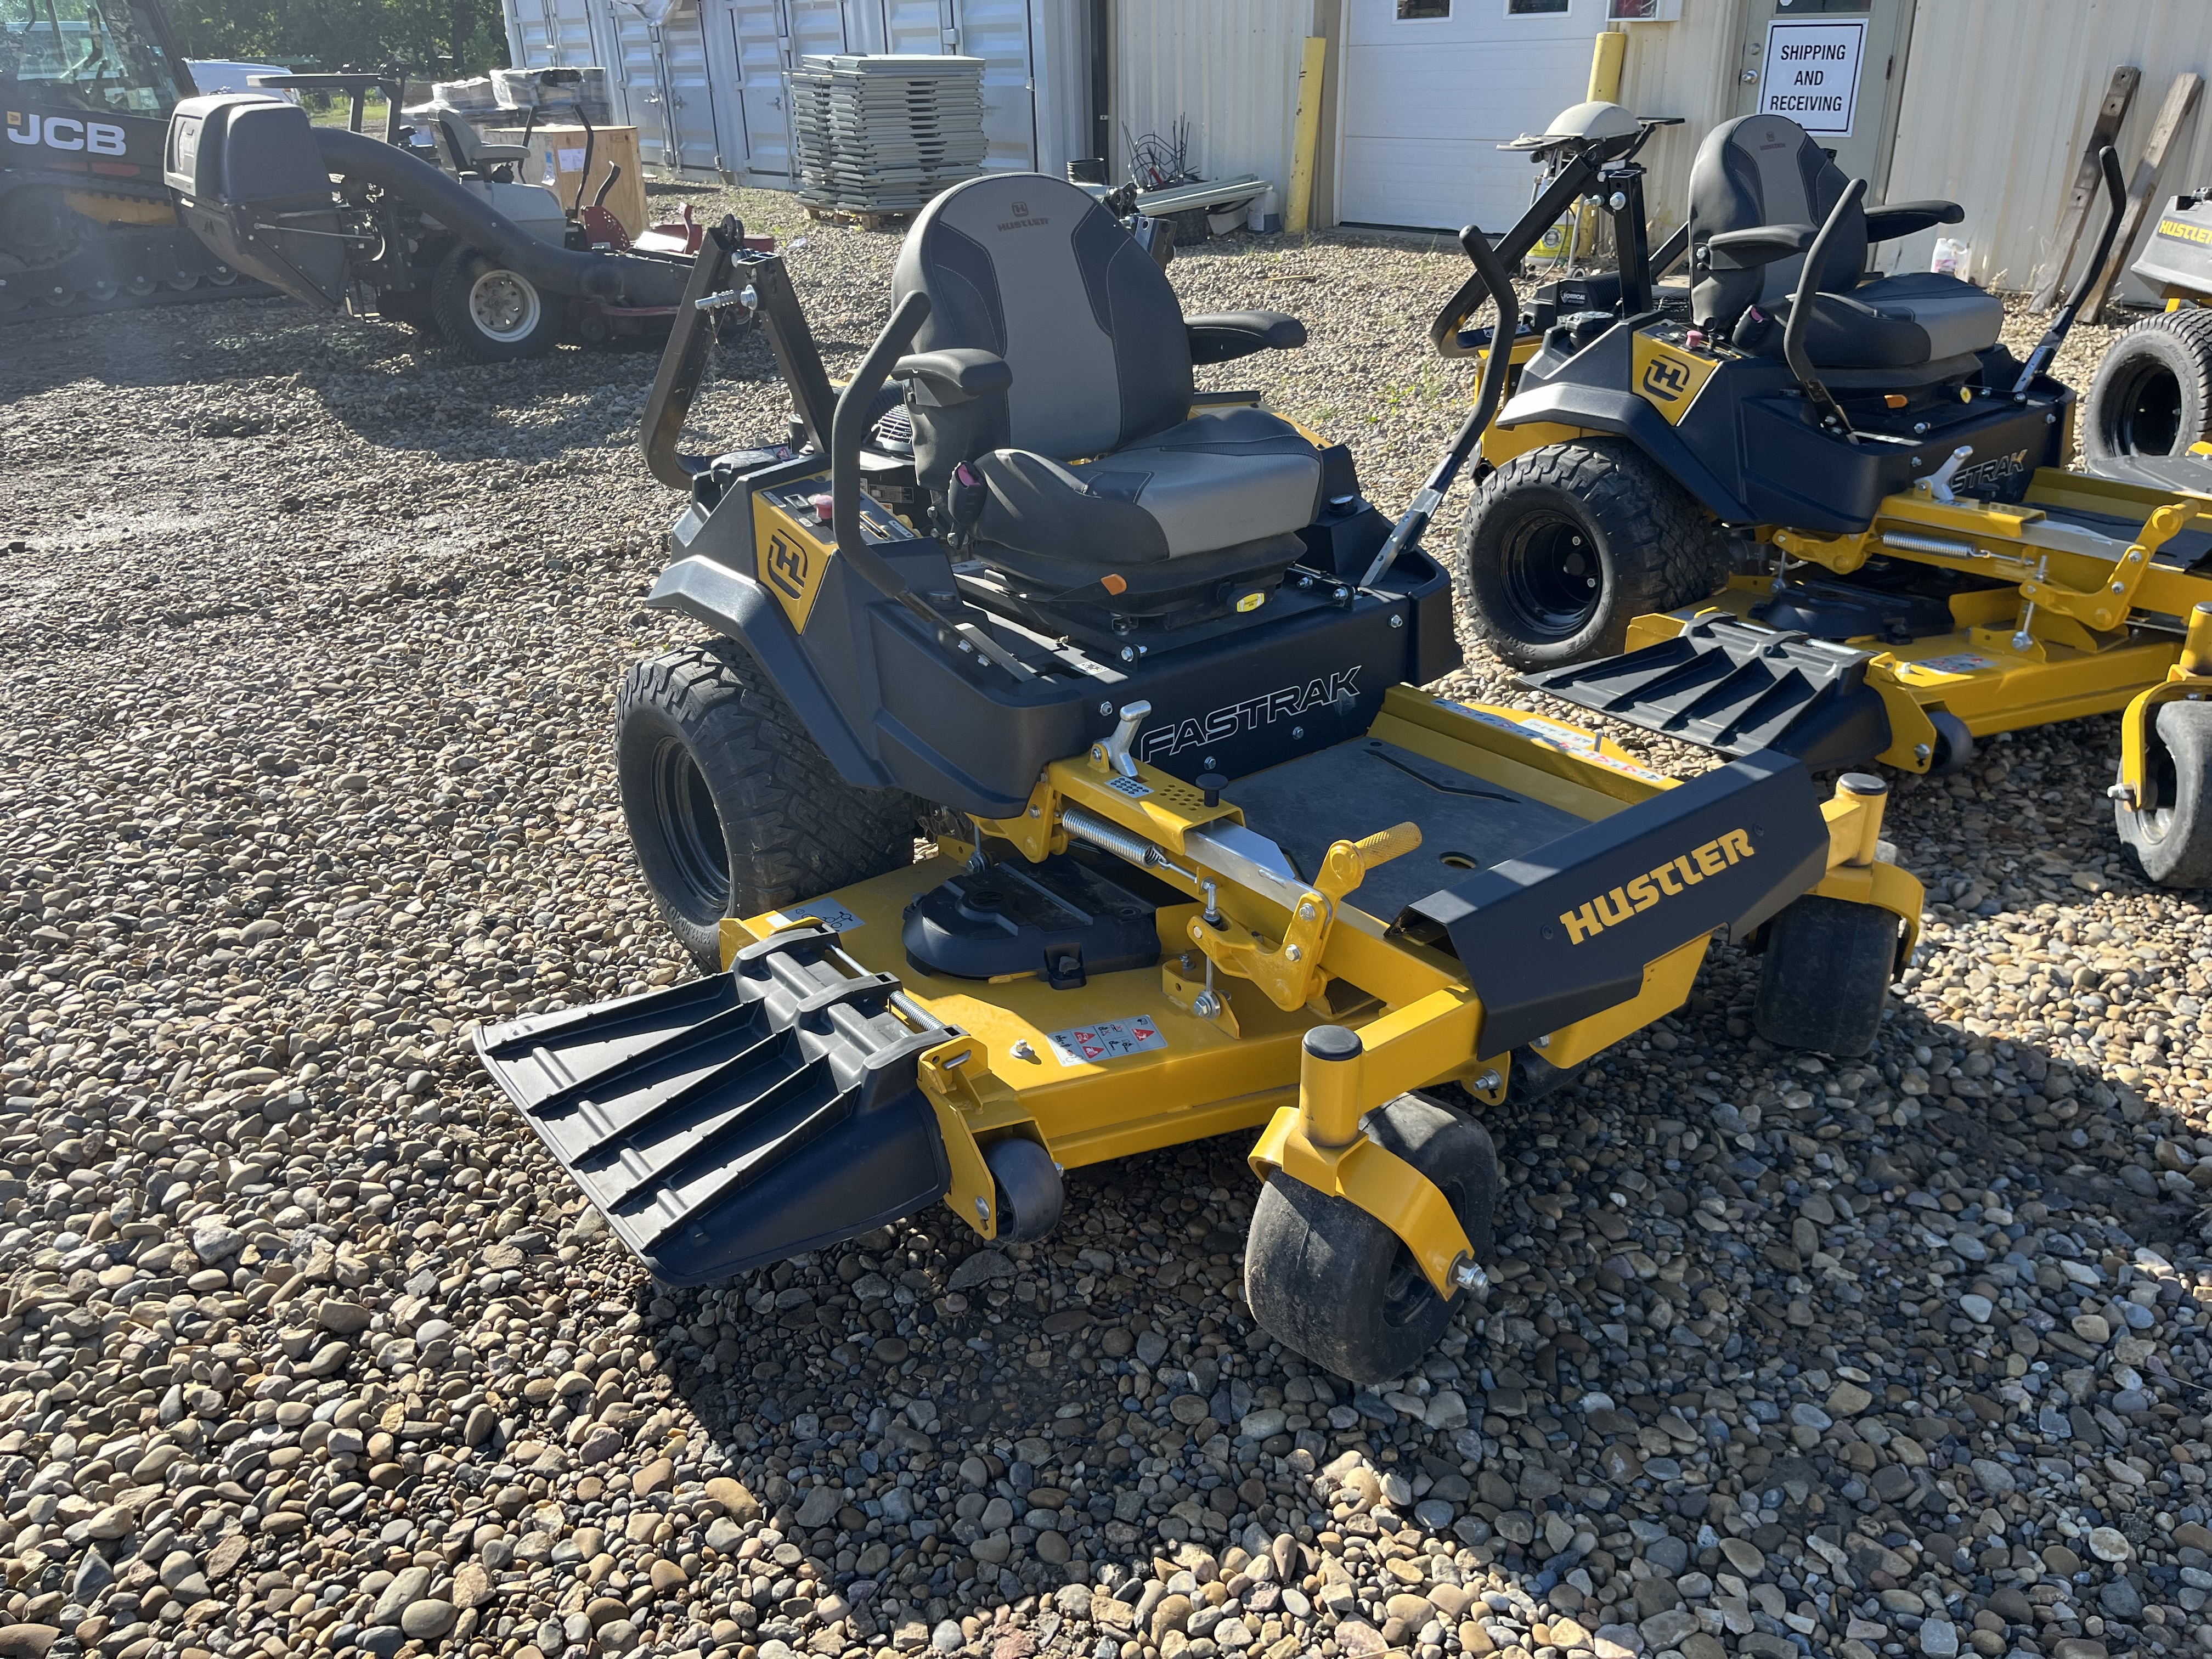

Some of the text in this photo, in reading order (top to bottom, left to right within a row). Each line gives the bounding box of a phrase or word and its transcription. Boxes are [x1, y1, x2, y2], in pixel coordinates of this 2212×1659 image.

[1781, 45, 1846, 60] SHIPPING
[1794, 70, 1824, 86] AND
[1770, 95, 1842, 111] RECEIVING
[7, 114, 126, 156] JCB
[996, 217, 1050, 232] HUSTLER
[1948, 448, 2028, 494] STRAK
[1141, 665, 1362, 764] FASTRAK
[1559, 828, 1755, 945] HUSTLER
